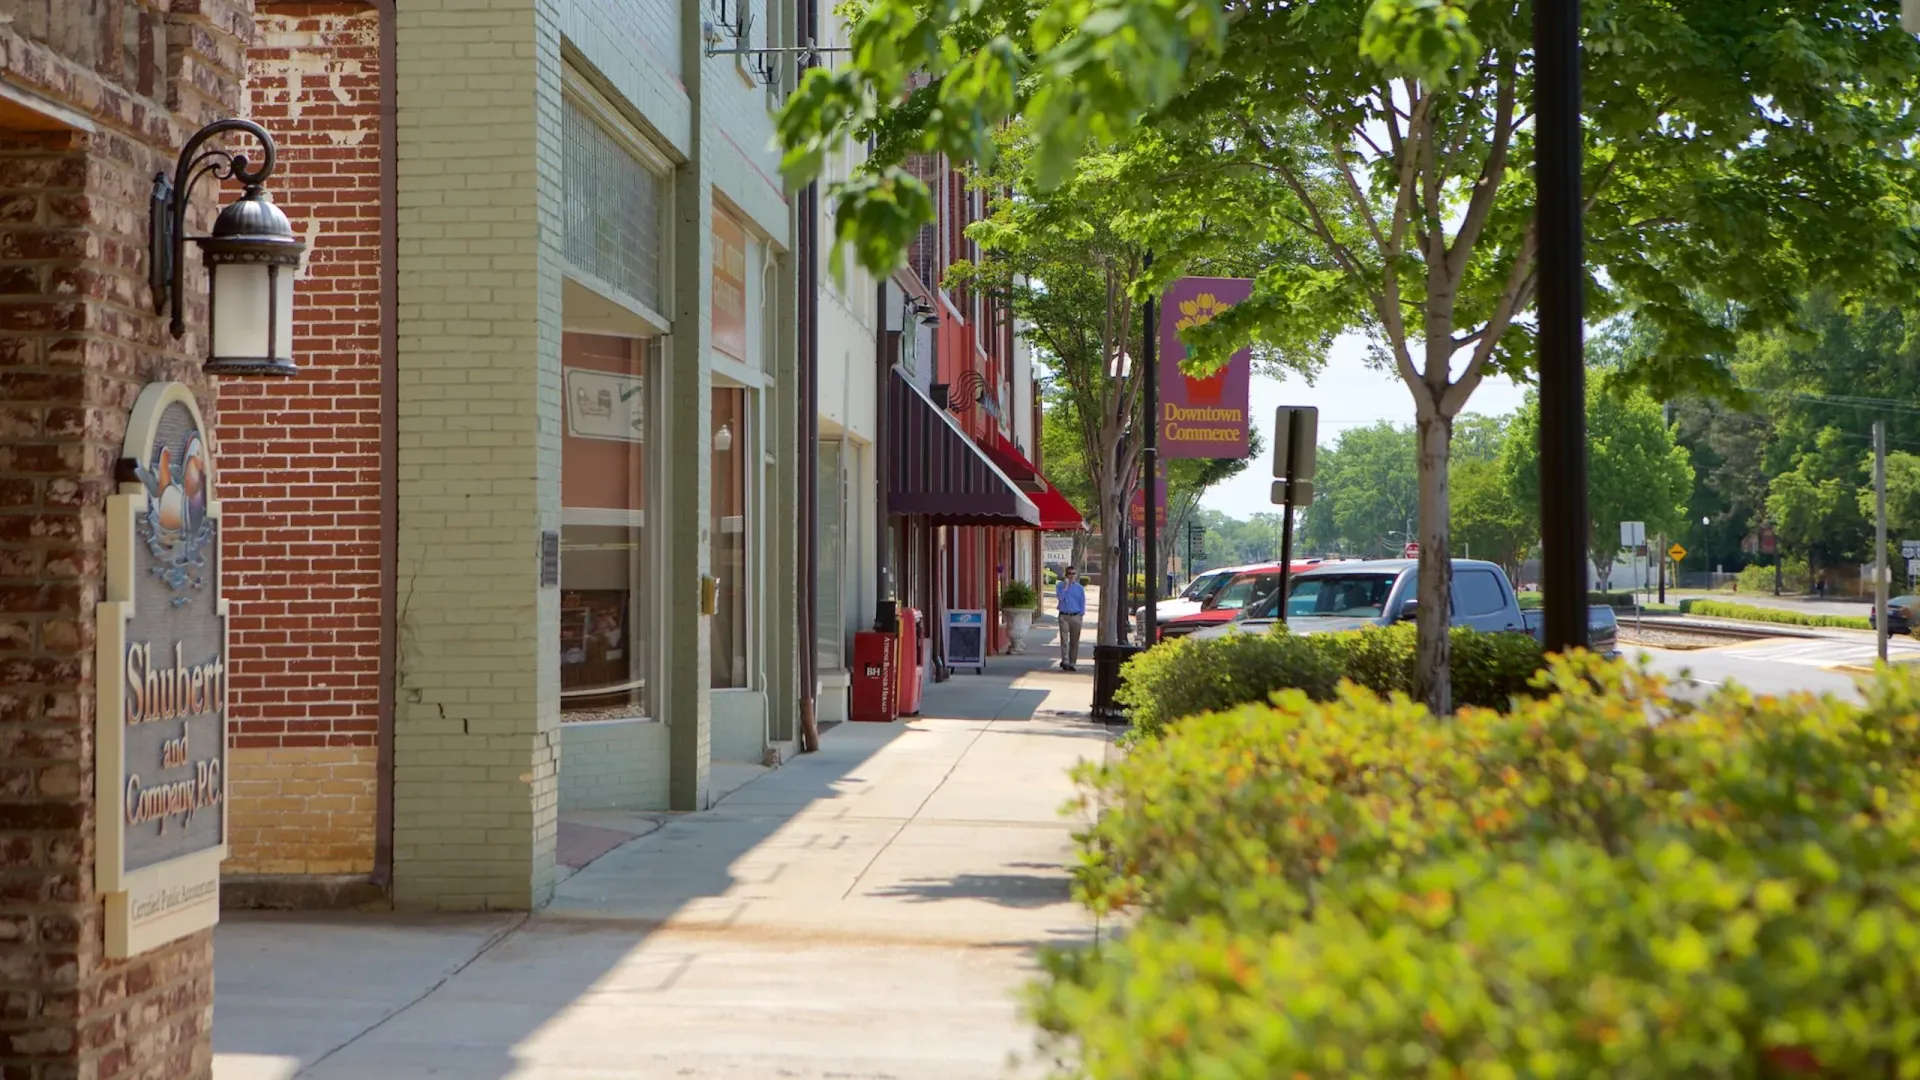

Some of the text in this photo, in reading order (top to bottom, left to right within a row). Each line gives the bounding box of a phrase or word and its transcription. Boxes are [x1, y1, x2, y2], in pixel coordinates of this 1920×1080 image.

[1164, 403, 1242, 421] Downtown
[1165, 423, 1240, 441] Commerce
[866, 667, 880, 676] BH
[127, 641, 223, 725] Shubert
[163, 722, 188, 769] and
